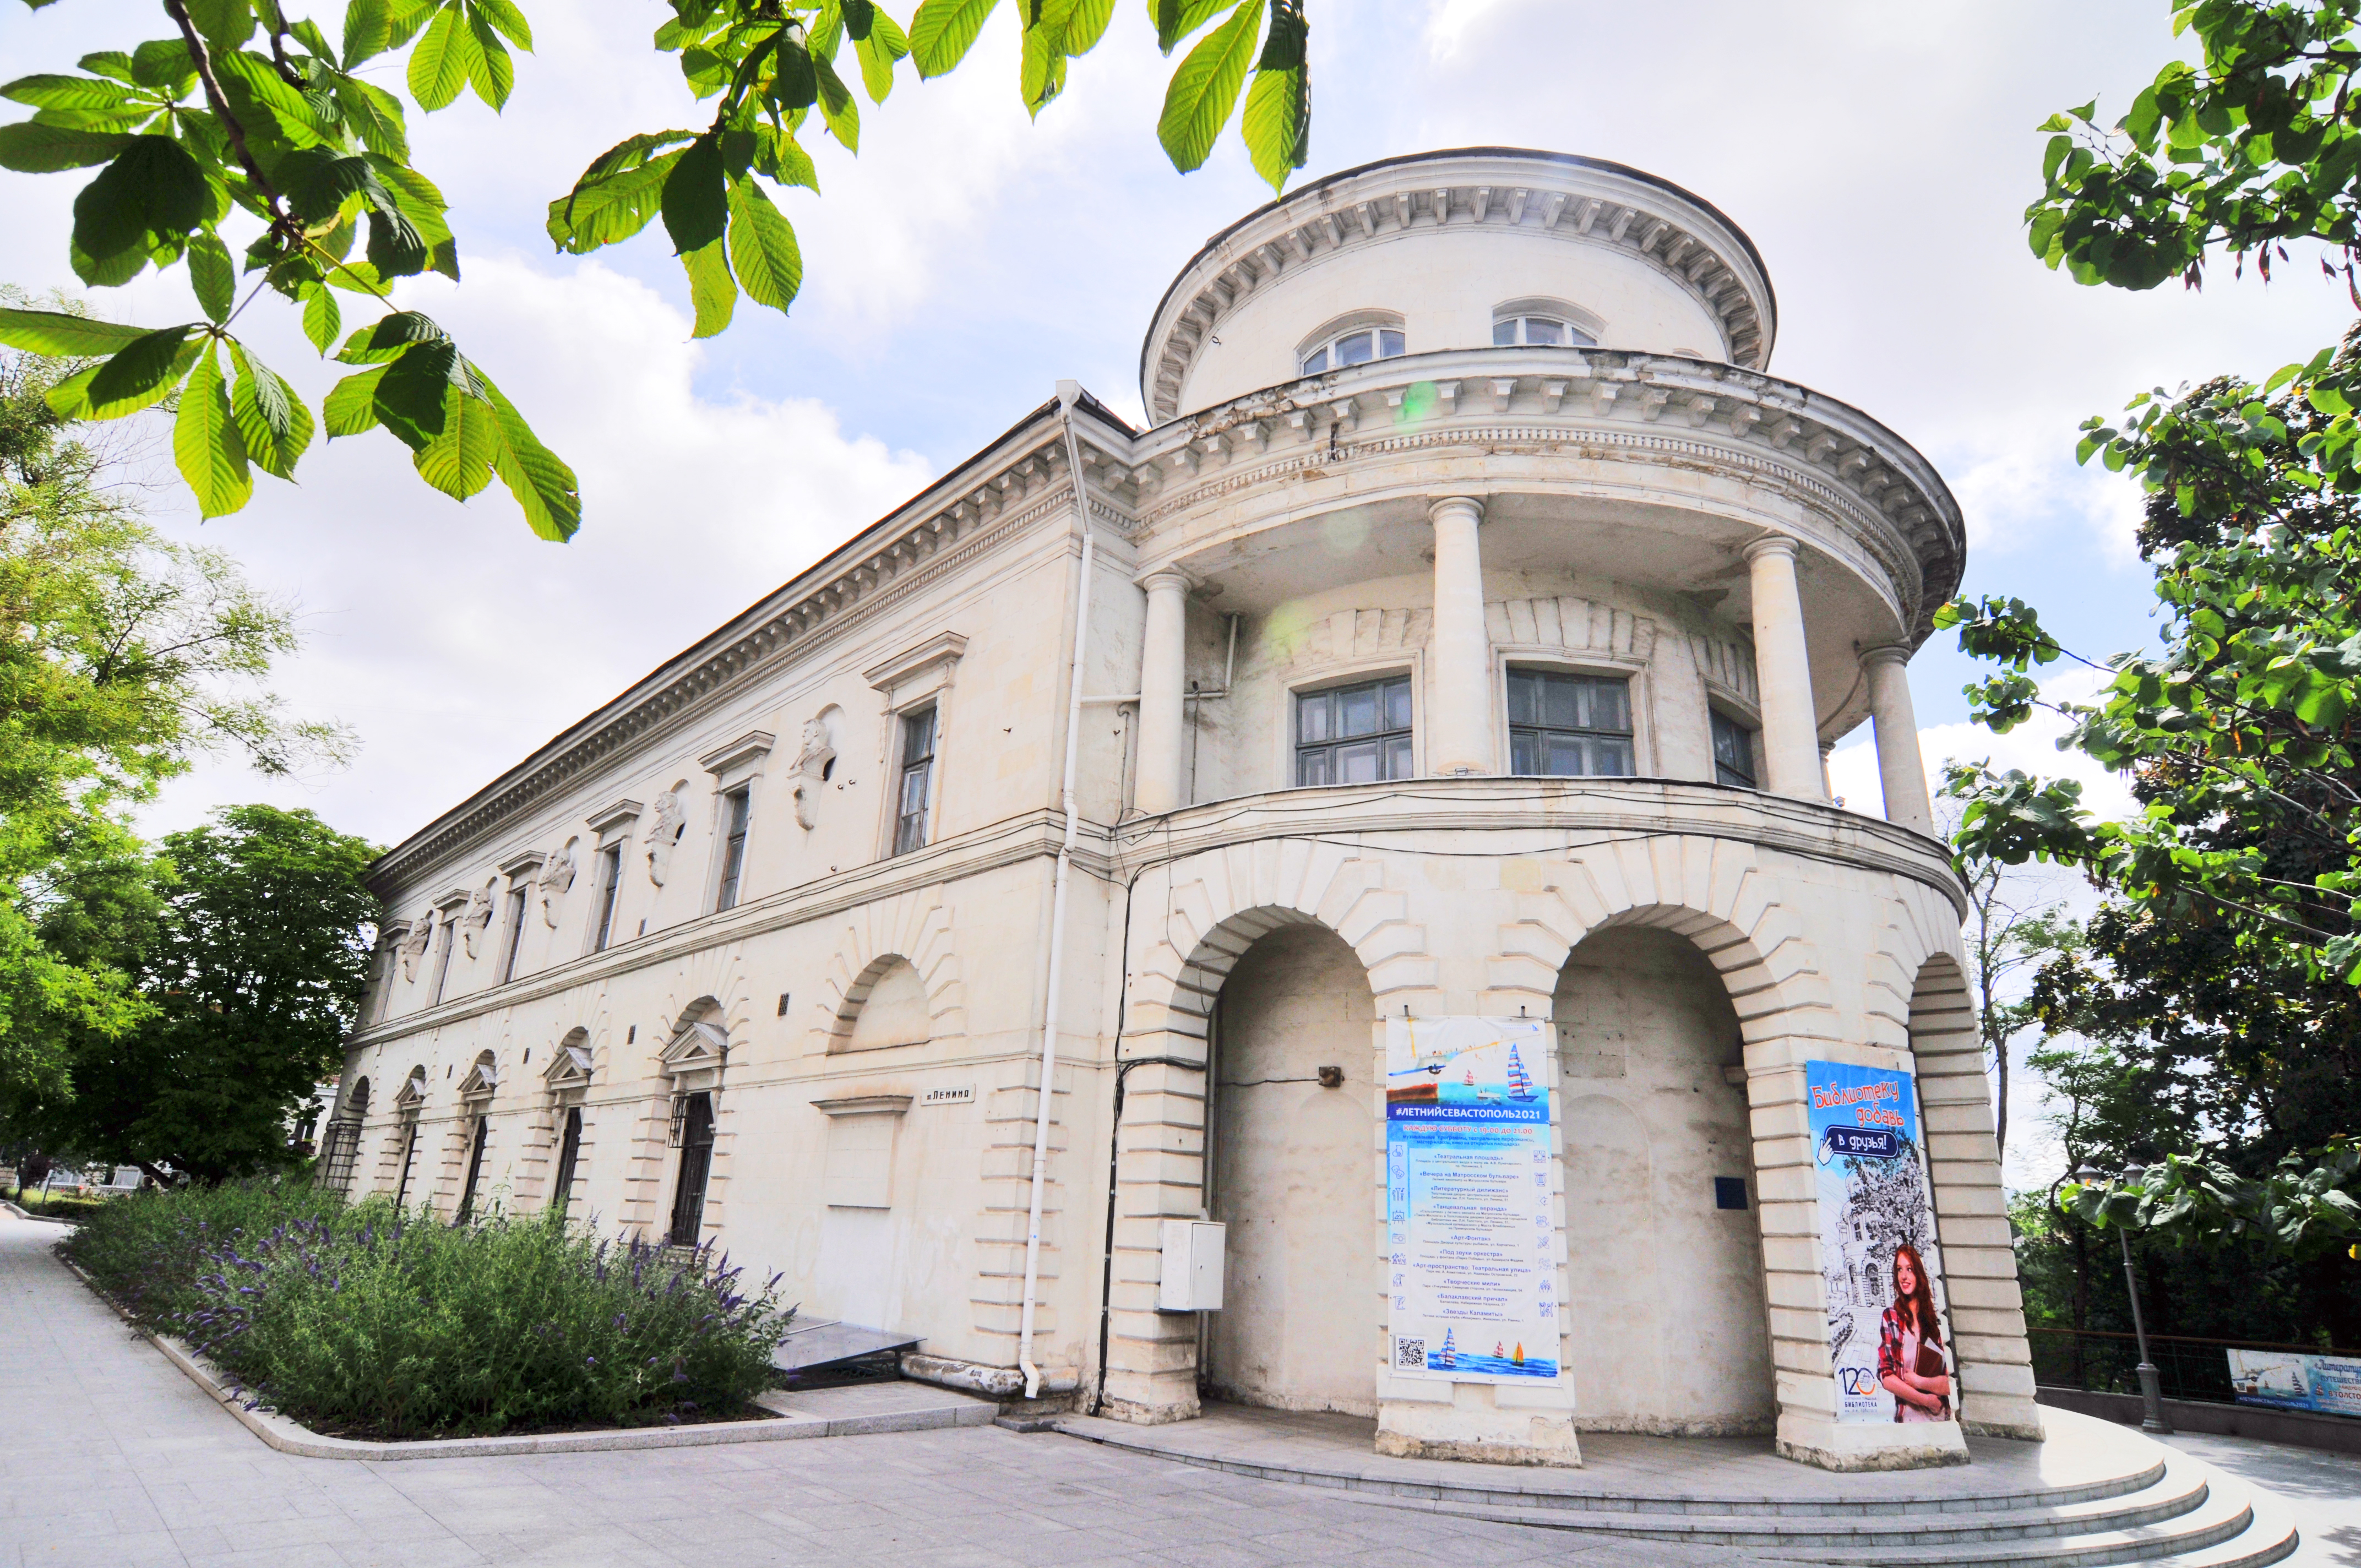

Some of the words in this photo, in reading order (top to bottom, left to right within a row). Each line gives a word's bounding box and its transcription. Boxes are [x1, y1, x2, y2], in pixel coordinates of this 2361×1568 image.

[1810, 1081, 1900, 1109] Библиотеку
[1396, 1106, 1540, 1119] #ЛЕТНИЙСЕВАСТОПОЛЬ2021
[1856, 1102, 1905, 1127] добавь
[1849, 1135, 1887, 1151] друзья!
[1444, 1278, 1480, 1287] «Творческие
[1838, 1367, 1876, 1395] 120
